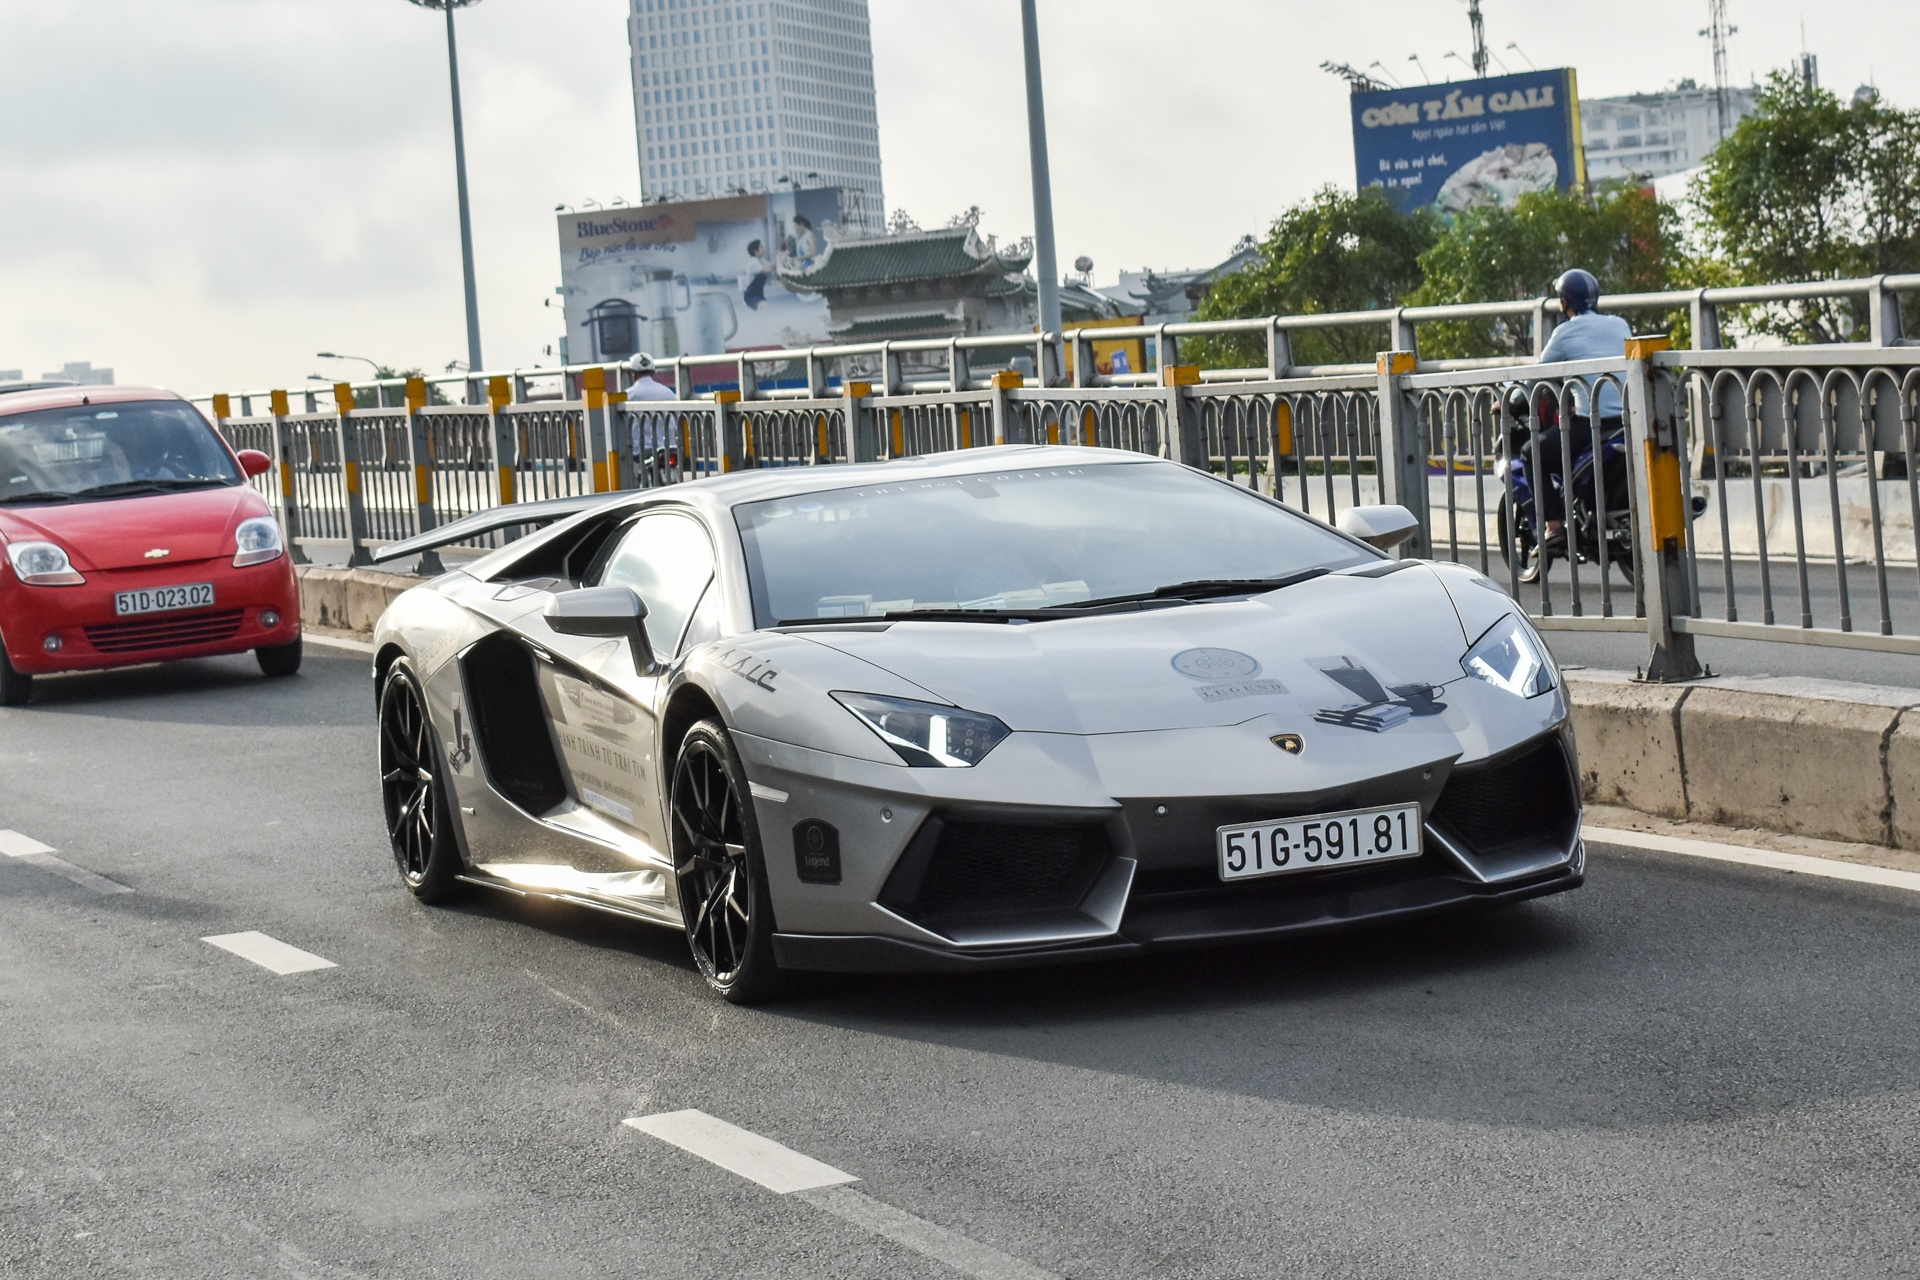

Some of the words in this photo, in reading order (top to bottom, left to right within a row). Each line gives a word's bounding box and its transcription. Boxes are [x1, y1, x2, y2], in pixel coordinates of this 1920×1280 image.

[1423, 88, 1485, 122] TẤM
[1488, 85, 1555, 114] CALI
[577, 217, 657, 239] BlueStone
[118, 585, 211, 613] 51D-023.02
[1226, 811, 1408, 872] 51G-591.81
